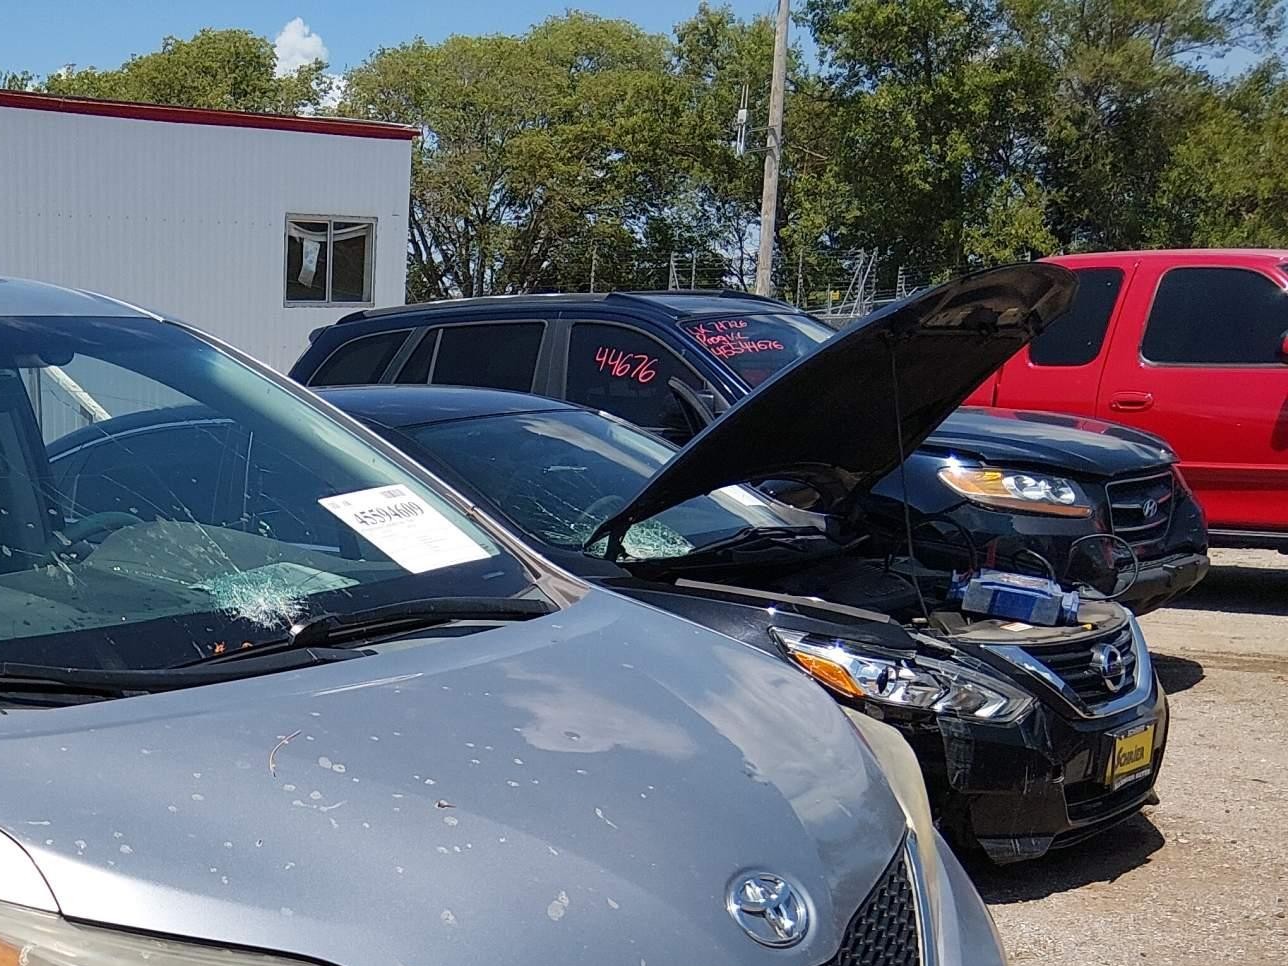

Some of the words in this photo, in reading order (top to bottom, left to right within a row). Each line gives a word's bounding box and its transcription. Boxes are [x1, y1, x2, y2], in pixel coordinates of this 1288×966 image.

[711, 339, 785, 360] 45544676
[595, 346, 659, 383] 44676
[353, 501, 425, 526] 45594609
